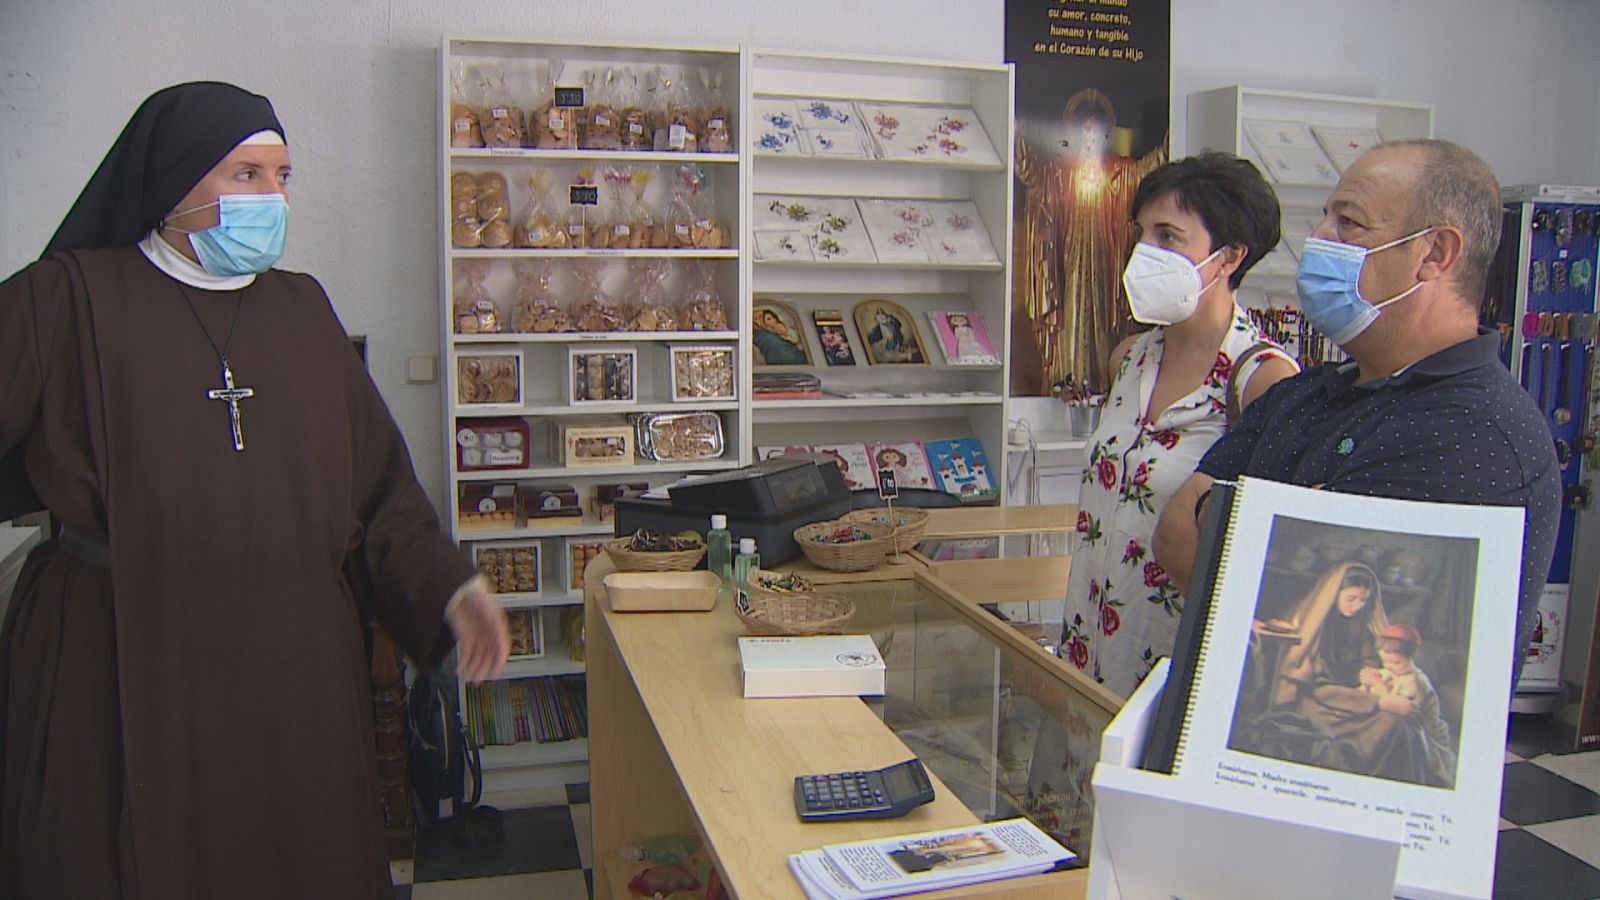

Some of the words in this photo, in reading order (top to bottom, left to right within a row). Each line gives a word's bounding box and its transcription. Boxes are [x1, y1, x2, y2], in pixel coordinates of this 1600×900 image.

[1048, 8, 1060, 17] su
[1062, 10, 1088, 21] amor,
[1090, 11, 1132, 26] concreto,
[1050, 23, 1085, 37] humano
[1087, 28, 1093, 41] y
[1095, 28, 1130, 42] tangible
[1034, 42, 1046, 52] en
[1048, 42, 1058, 53] el
[1060, 42, 1096, 56] Corazón
[1098, 46, 1110, 57] de
[1112, 48, 1123, 58] su
